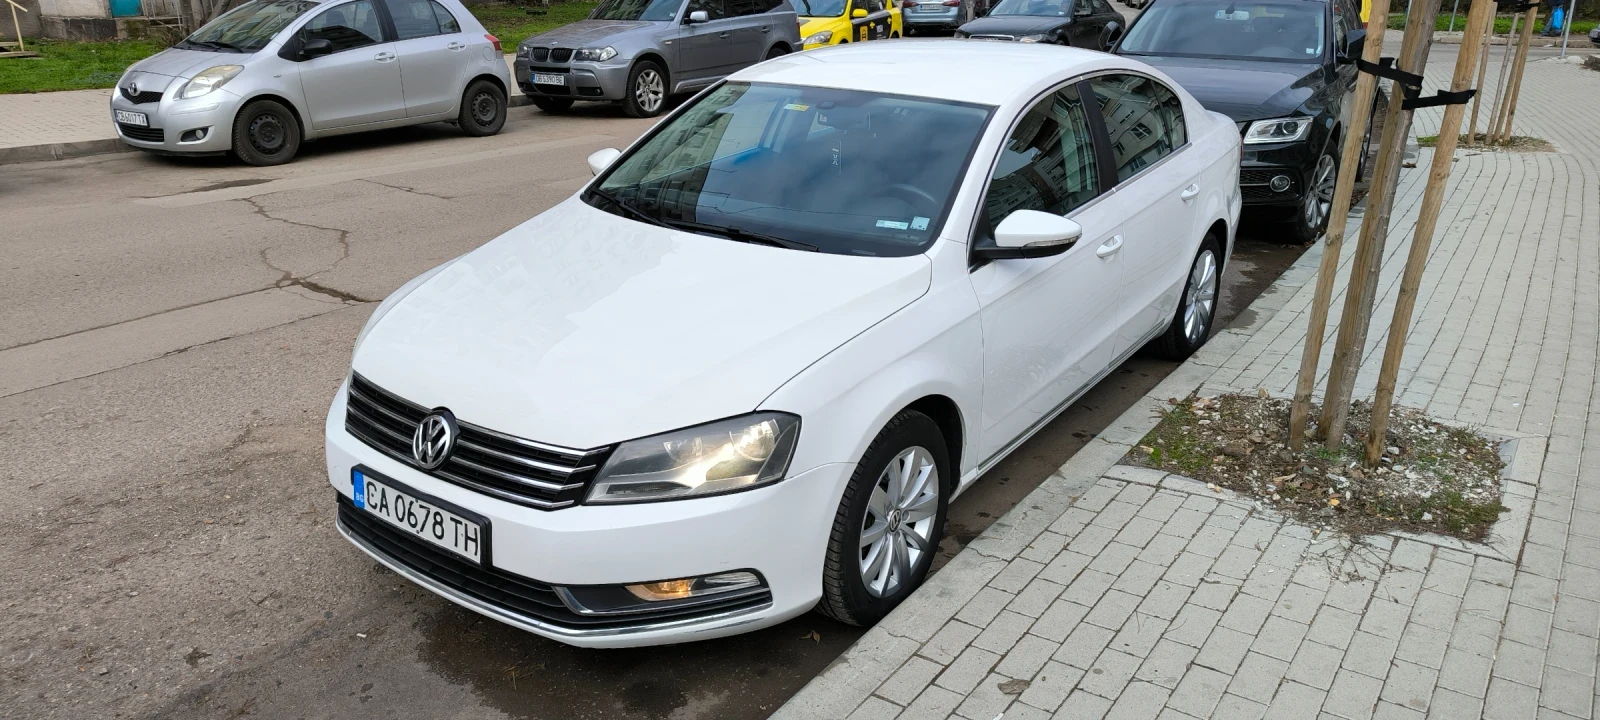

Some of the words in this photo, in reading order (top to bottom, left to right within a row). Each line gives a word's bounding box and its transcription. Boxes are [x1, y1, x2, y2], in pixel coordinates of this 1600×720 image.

[356, 492, 364, 503] BG
[366, 481, 391, 517] CA
[395, 494, 445, 540] 0678
[449, 516, 479, 556] TH
